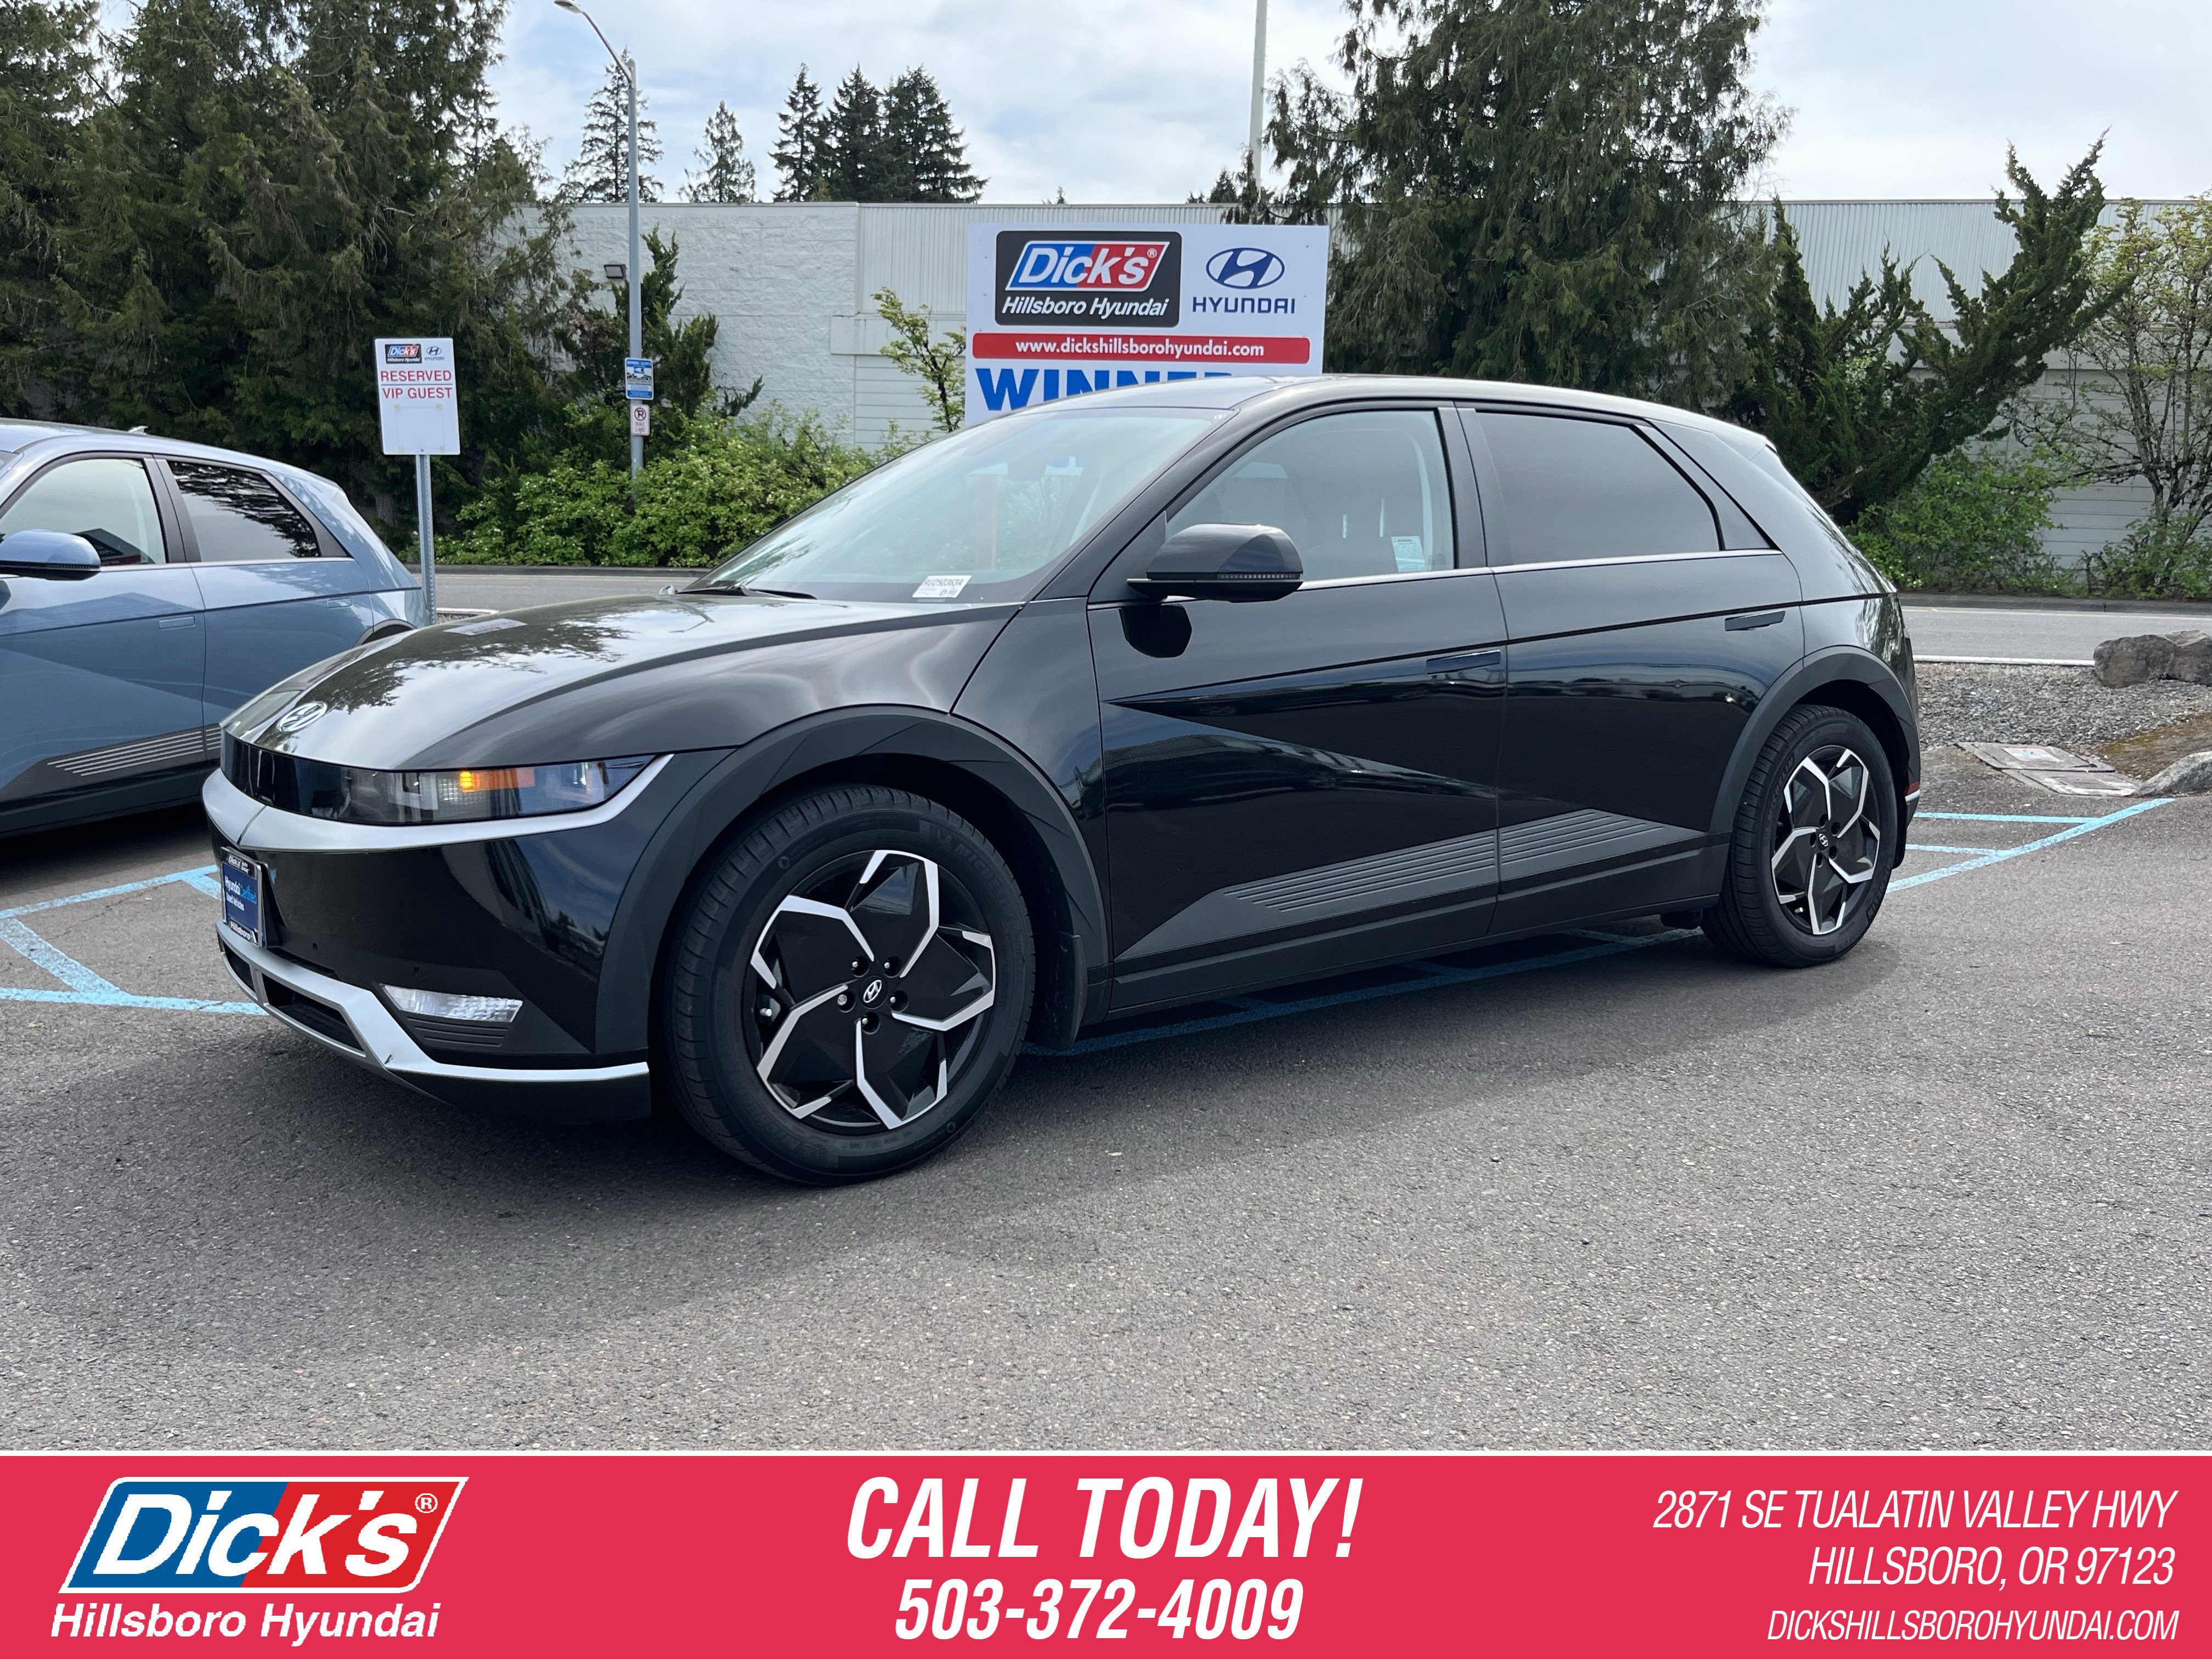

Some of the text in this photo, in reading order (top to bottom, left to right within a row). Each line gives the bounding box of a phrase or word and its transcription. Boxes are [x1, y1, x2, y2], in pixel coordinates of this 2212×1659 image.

[1019, 247, 1149, 284] Dick's
[1002, 297, 1170, 319] Hillsboro Hyundai
[1193, 297, 1295, 314] HYUNDAI
[1016, 338, 1264, 358] www.dickshillsborohyundai.com
[381, 370, 452, 382] RESERVED
[382, 387, 452, 398] VIP GUEST
[975, 368, 1232, 410] WIN
